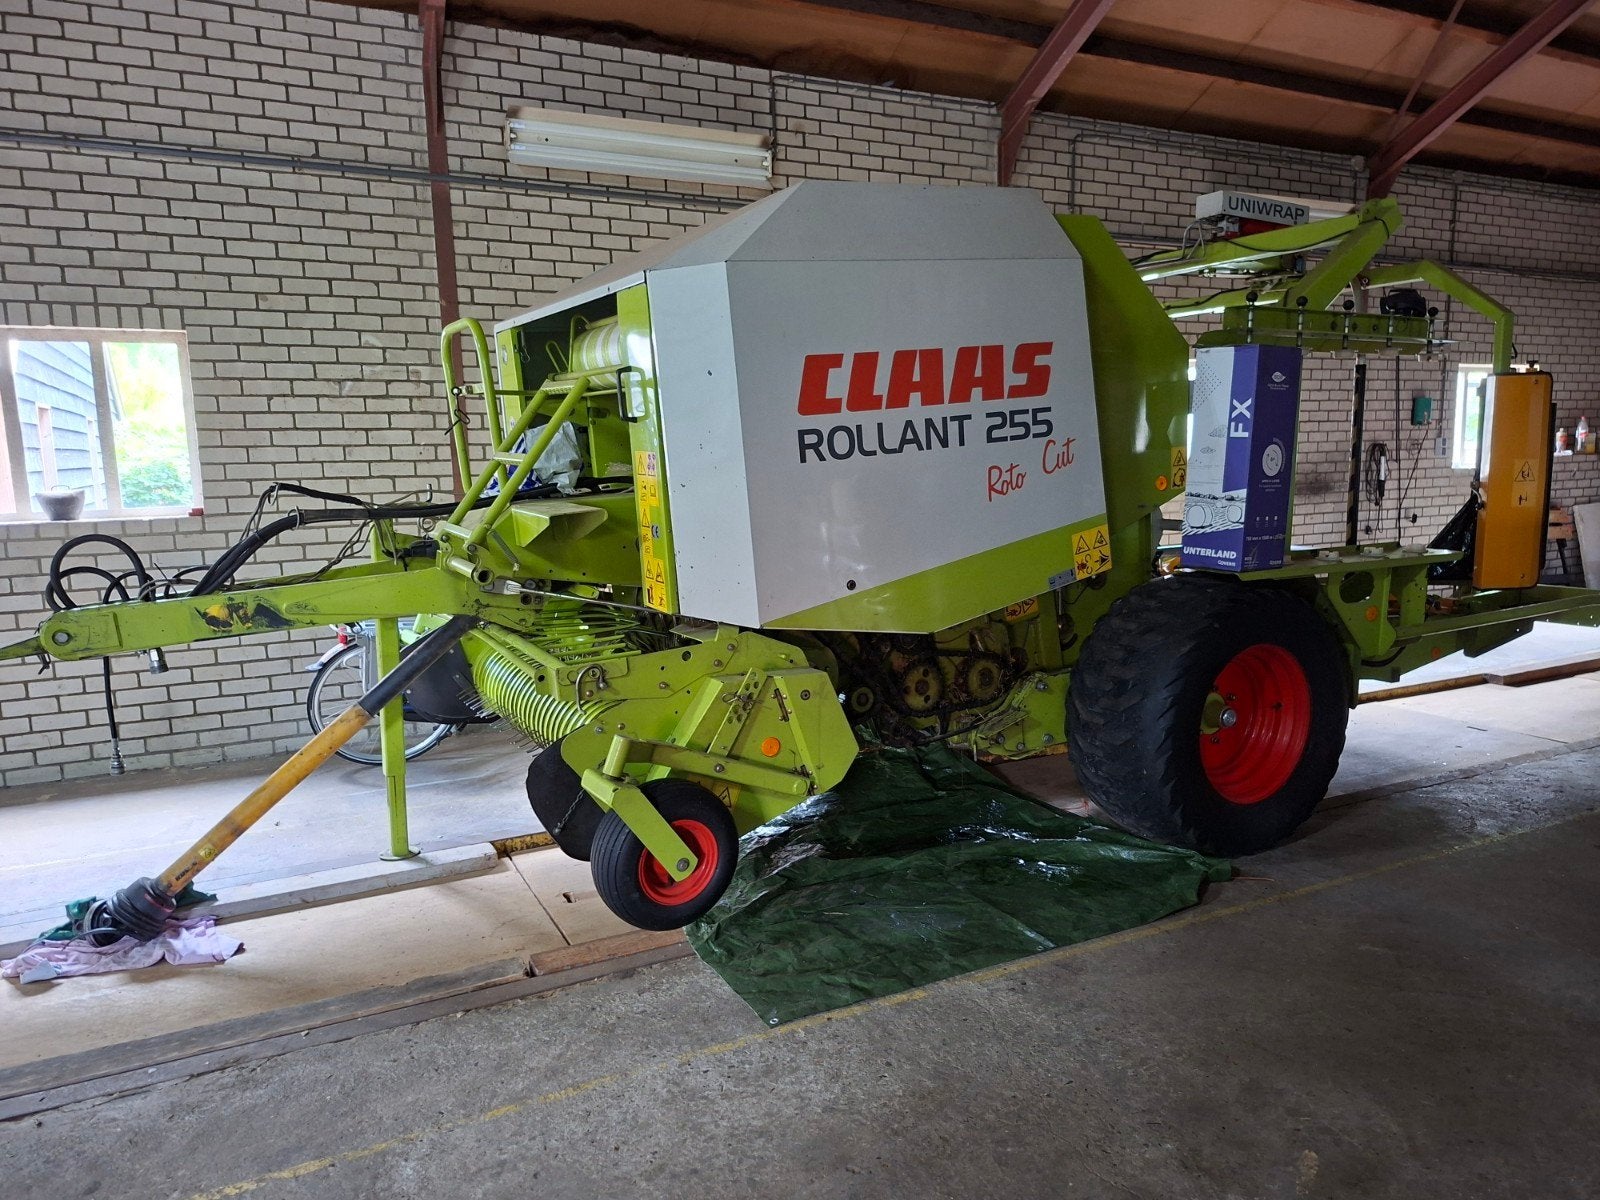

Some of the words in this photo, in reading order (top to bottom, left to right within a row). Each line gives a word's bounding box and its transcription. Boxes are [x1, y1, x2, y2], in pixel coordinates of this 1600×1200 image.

[1228, 195, 1305, 221] UNIWRAP
[797, 341, 1054, 416] CLAAS
[797, 414, 972, 464] ROLLANT
[985, 406, 1054, 444] 255
[1230, 398, 1252, 437] FX
[987, 462, 1027, 502] Roto
[1042, 437, 1077, 475] Cut
[1183, 546, 1237, 559] UNTERLAND
